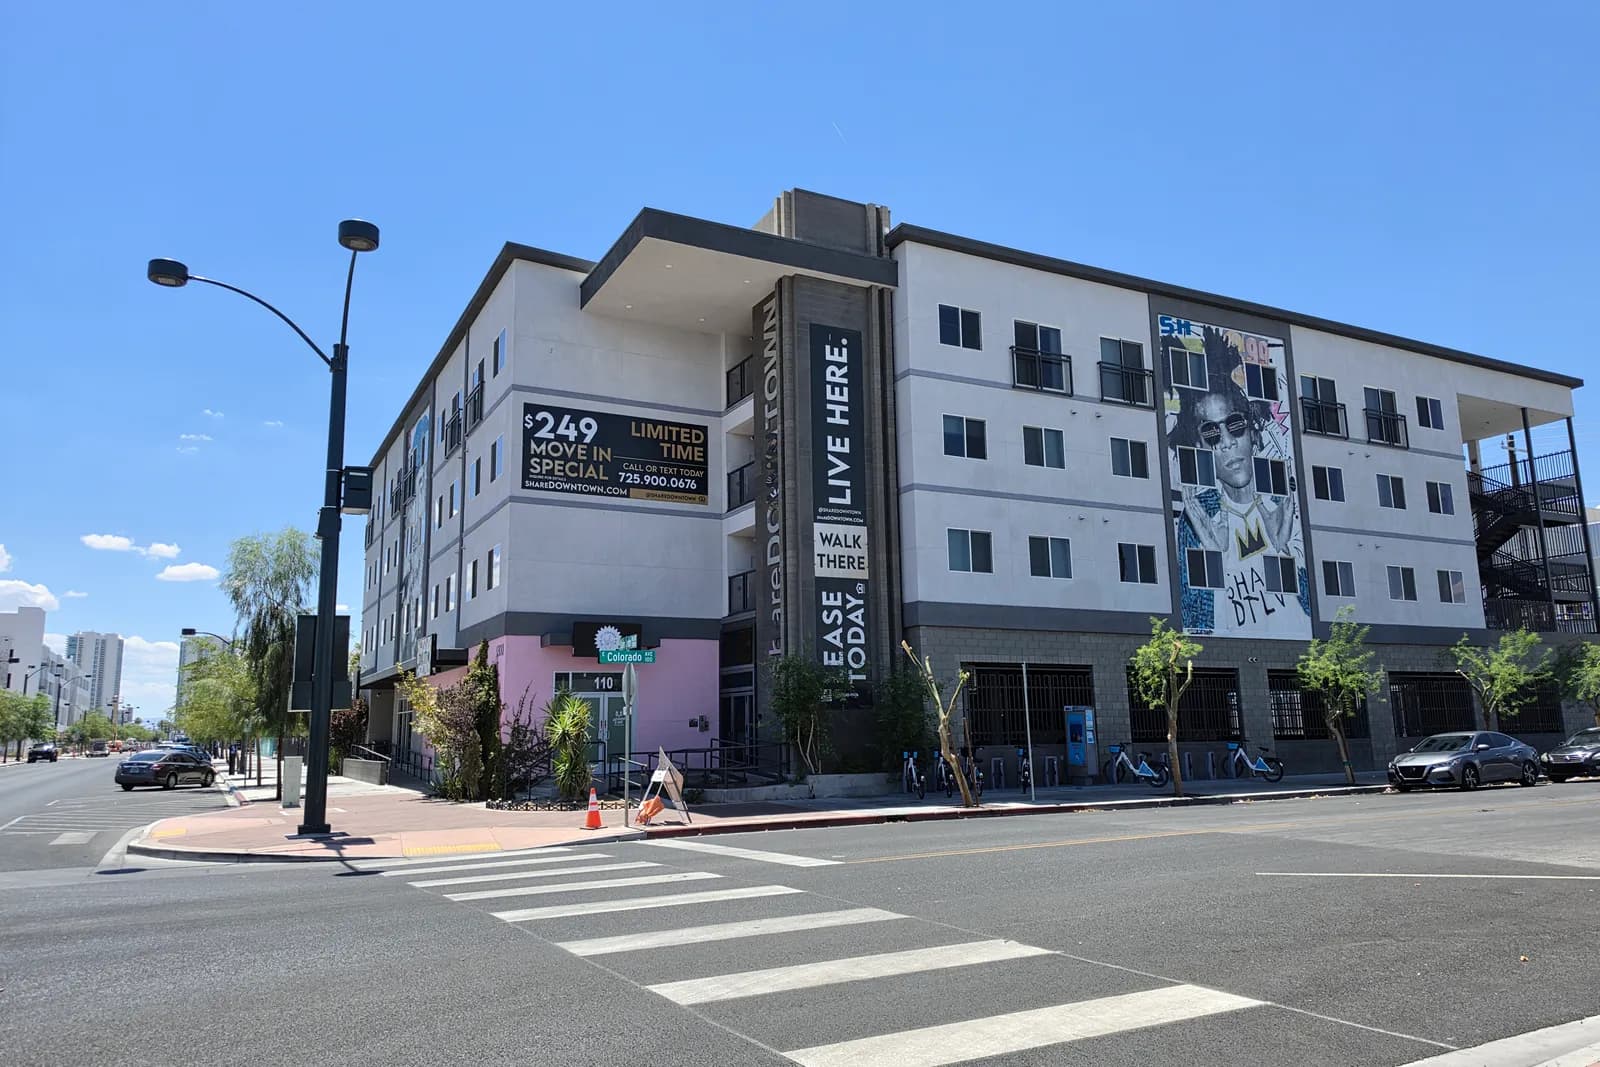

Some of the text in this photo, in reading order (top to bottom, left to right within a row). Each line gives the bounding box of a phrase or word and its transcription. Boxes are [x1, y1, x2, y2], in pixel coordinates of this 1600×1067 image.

[524, 411, 598, 444] $249
[825, 337, 851, 505] LIVE HERE.
[631, 421, 704, 444] LIMITED
[529, 439, 611, 463] MOVE IN
[660, 442, 704, 462] TIME
[529, 457, 609, 481] SPECIAL
[623, 462, 704, 478] CALL OR TEXT TODAY
[525, 480, 628, 496] SHAREDOWNTOWN.COM
[618, 472, 697, 490] 725.900.0676
[819, 532, 862, 549] WALK
[816, 553, 865, 570] THERE
[821, 591, 844, 684] EASE
[845, 592, 867, 684] TODAY
[607, 652, 642, 662] Colorado
[594, 677, 613, 689] 110
